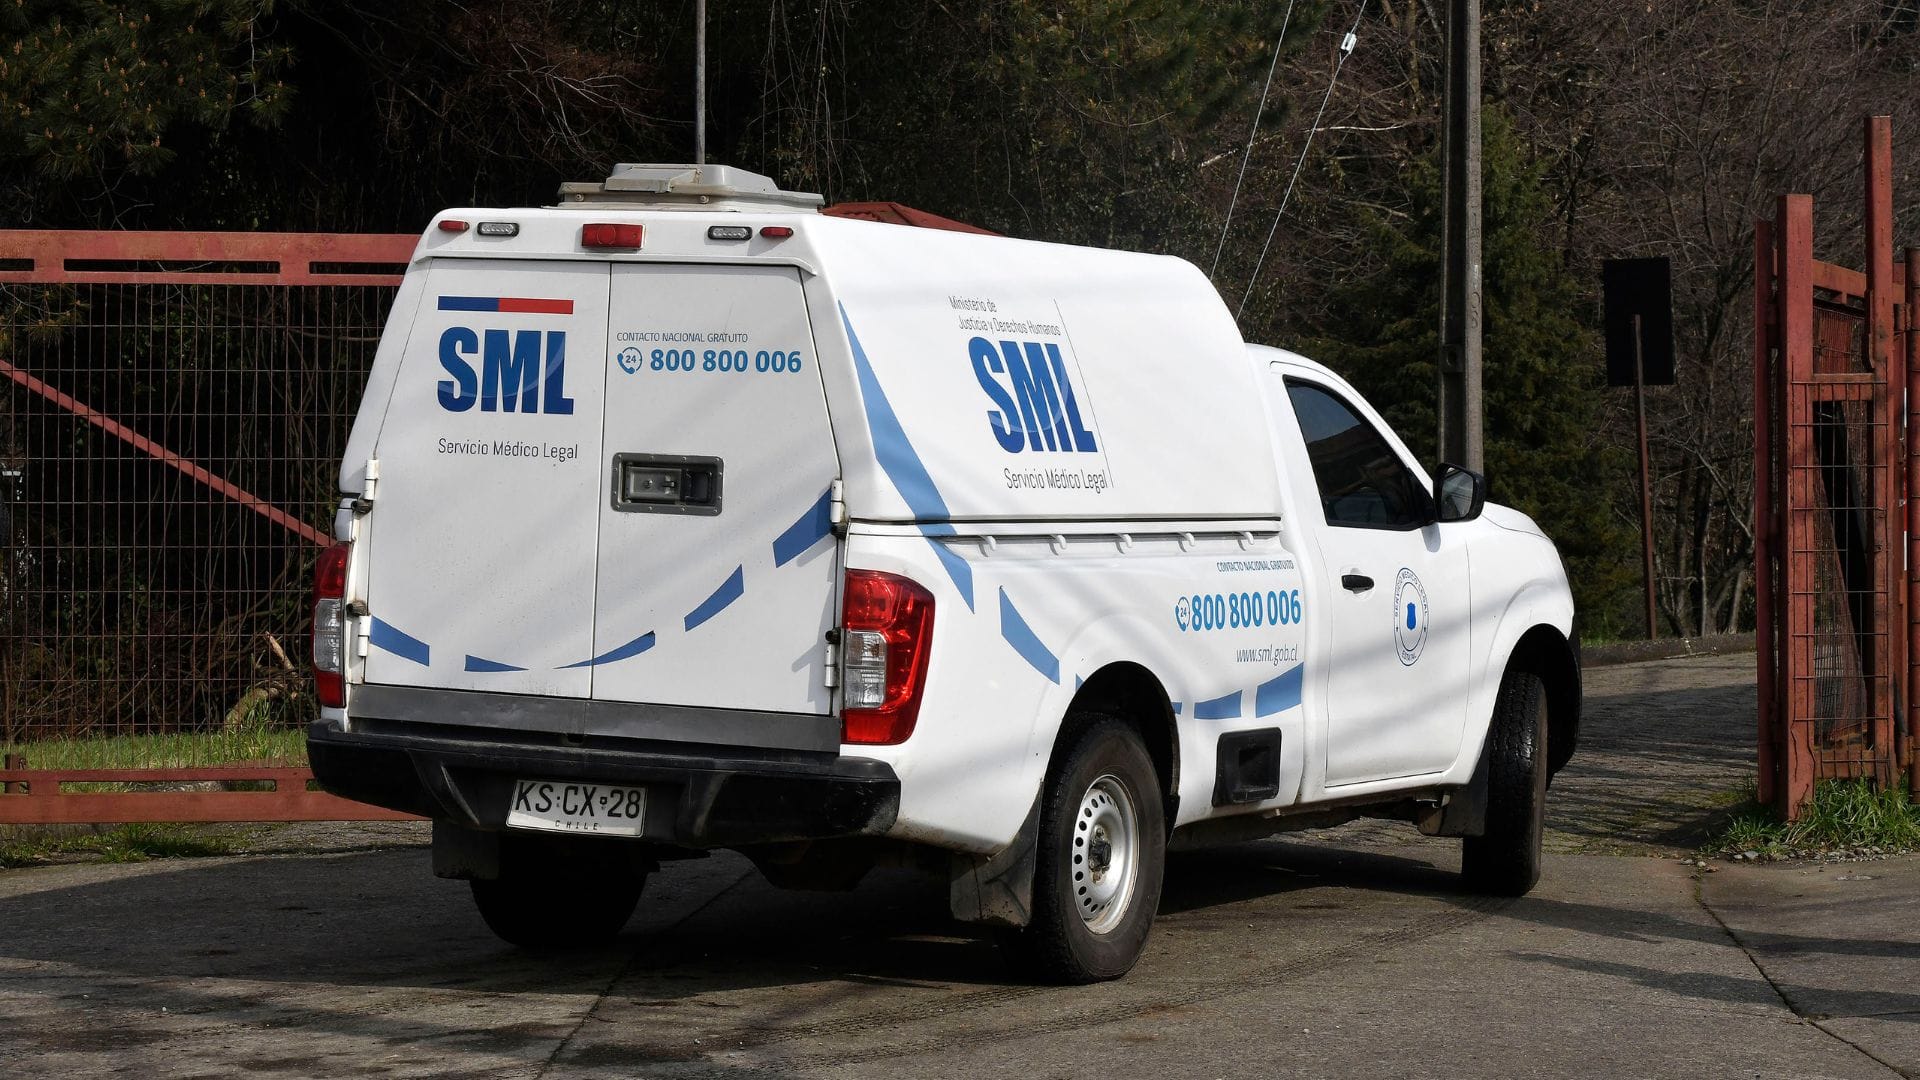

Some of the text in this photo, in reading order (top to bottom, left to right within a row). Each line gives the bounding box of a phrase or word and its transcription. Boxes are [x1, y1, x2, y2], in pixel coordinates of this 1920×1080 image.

[948, 296, 997, 312] Ministerio de
[959, 315, 1061, 336] Justicia y Derechos Humanos
[616, 332, 748, 343] CONTACTO NACIONAL GRATUITO
[437, 326, 574, 415] SML
[625, 349, 802, 373] 24 800 800 006
[968, 336, 1098, 454] SML
[438, 437, 578, 462] Servicio Médico Legal
[1004, 468, 1108, 494] Servicio Médico Legal
[1216, 559, 1295, 573] CONTACTO NACIONAL GRATUITO
[1180, 589, 1301, 631] 24 800 800 006
[1236, 643, 1298, 666] www.sml.gob.cl
[555, 819, 599, 831] CHILE
